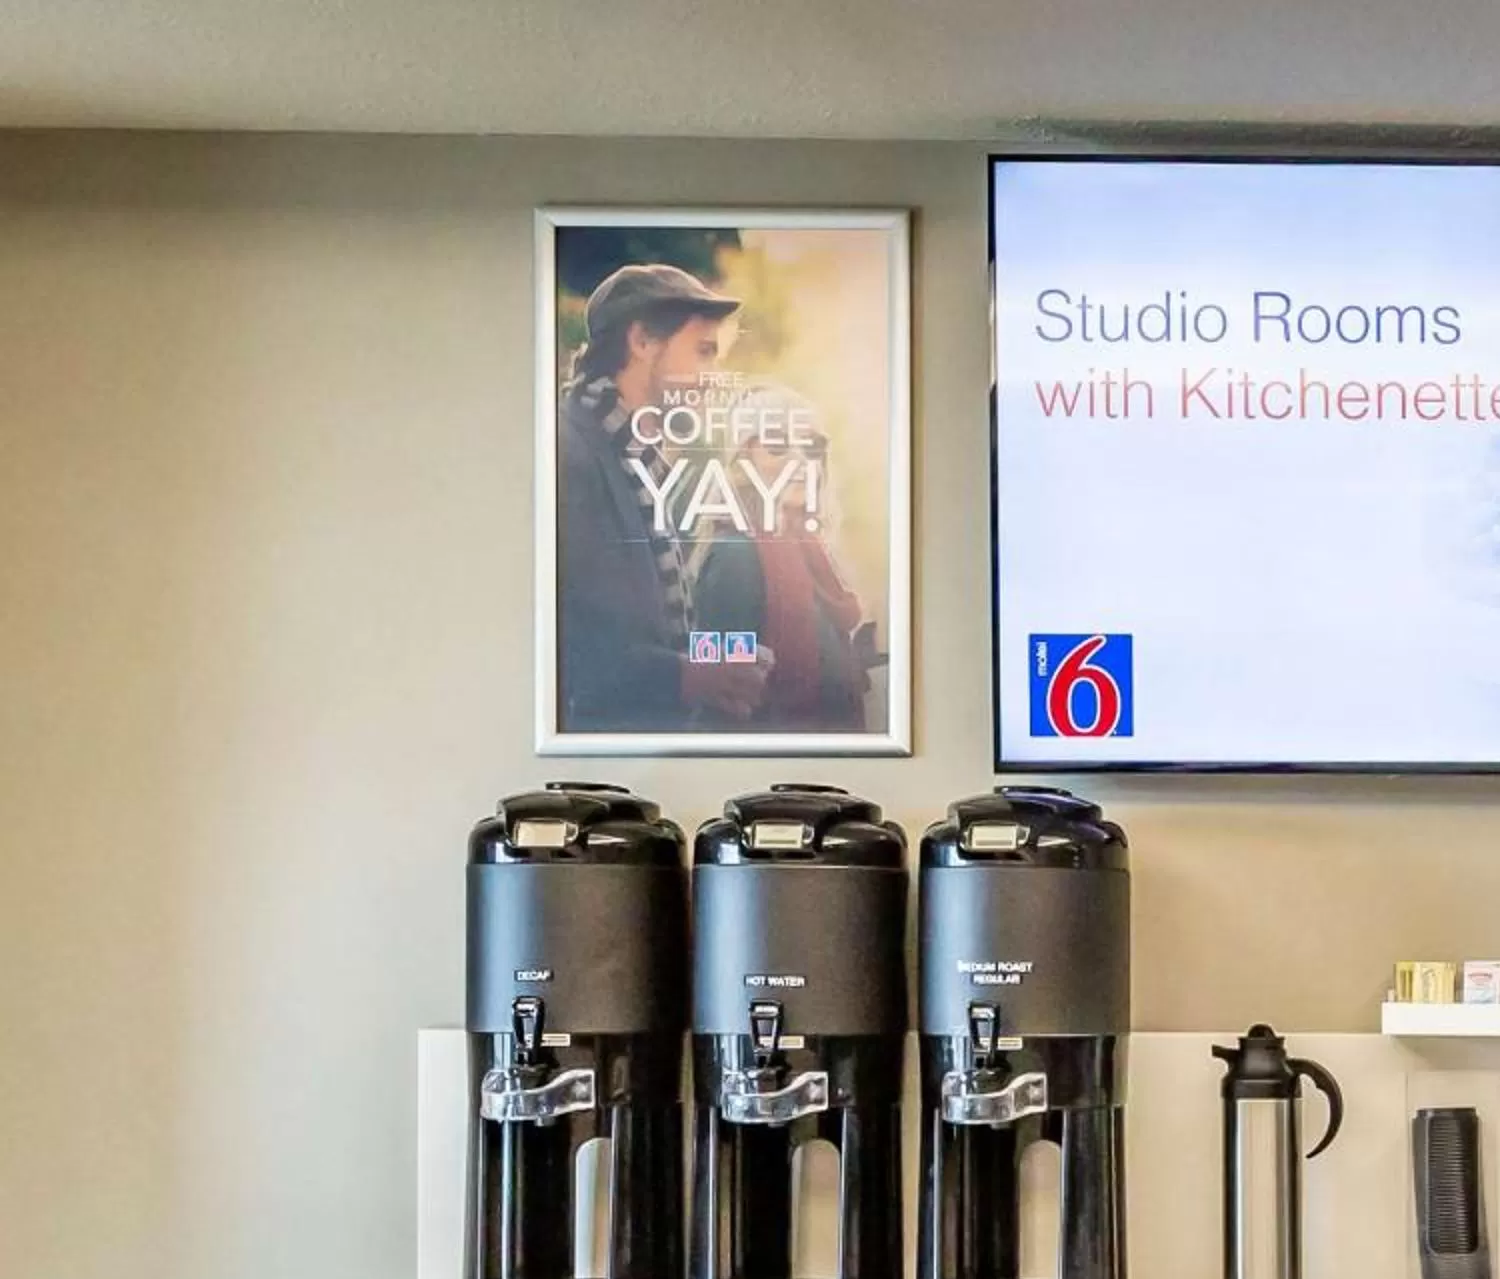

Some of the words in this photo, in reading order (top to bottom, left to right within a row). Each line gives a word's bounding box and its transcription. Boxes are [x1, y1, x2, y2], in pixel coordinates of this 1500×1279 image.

[1036, 289, 1228, 343] Studio
[1253, 291, 1462, 345] Rooms
[699, 371, 744, 387] FREE
[1036, 367, 1154, 419] with
[631, 406, 814, 446] COFFEE
[628, 458, 820, 533] YAY!
[1046, 635, 1121, 738] 6
[517, 970, 551, 981] DECAF
[745, 975, 766, 987] HOT
[768, 975, 805, 987] WATER
[998, 962, 1032, 973] ROAST
